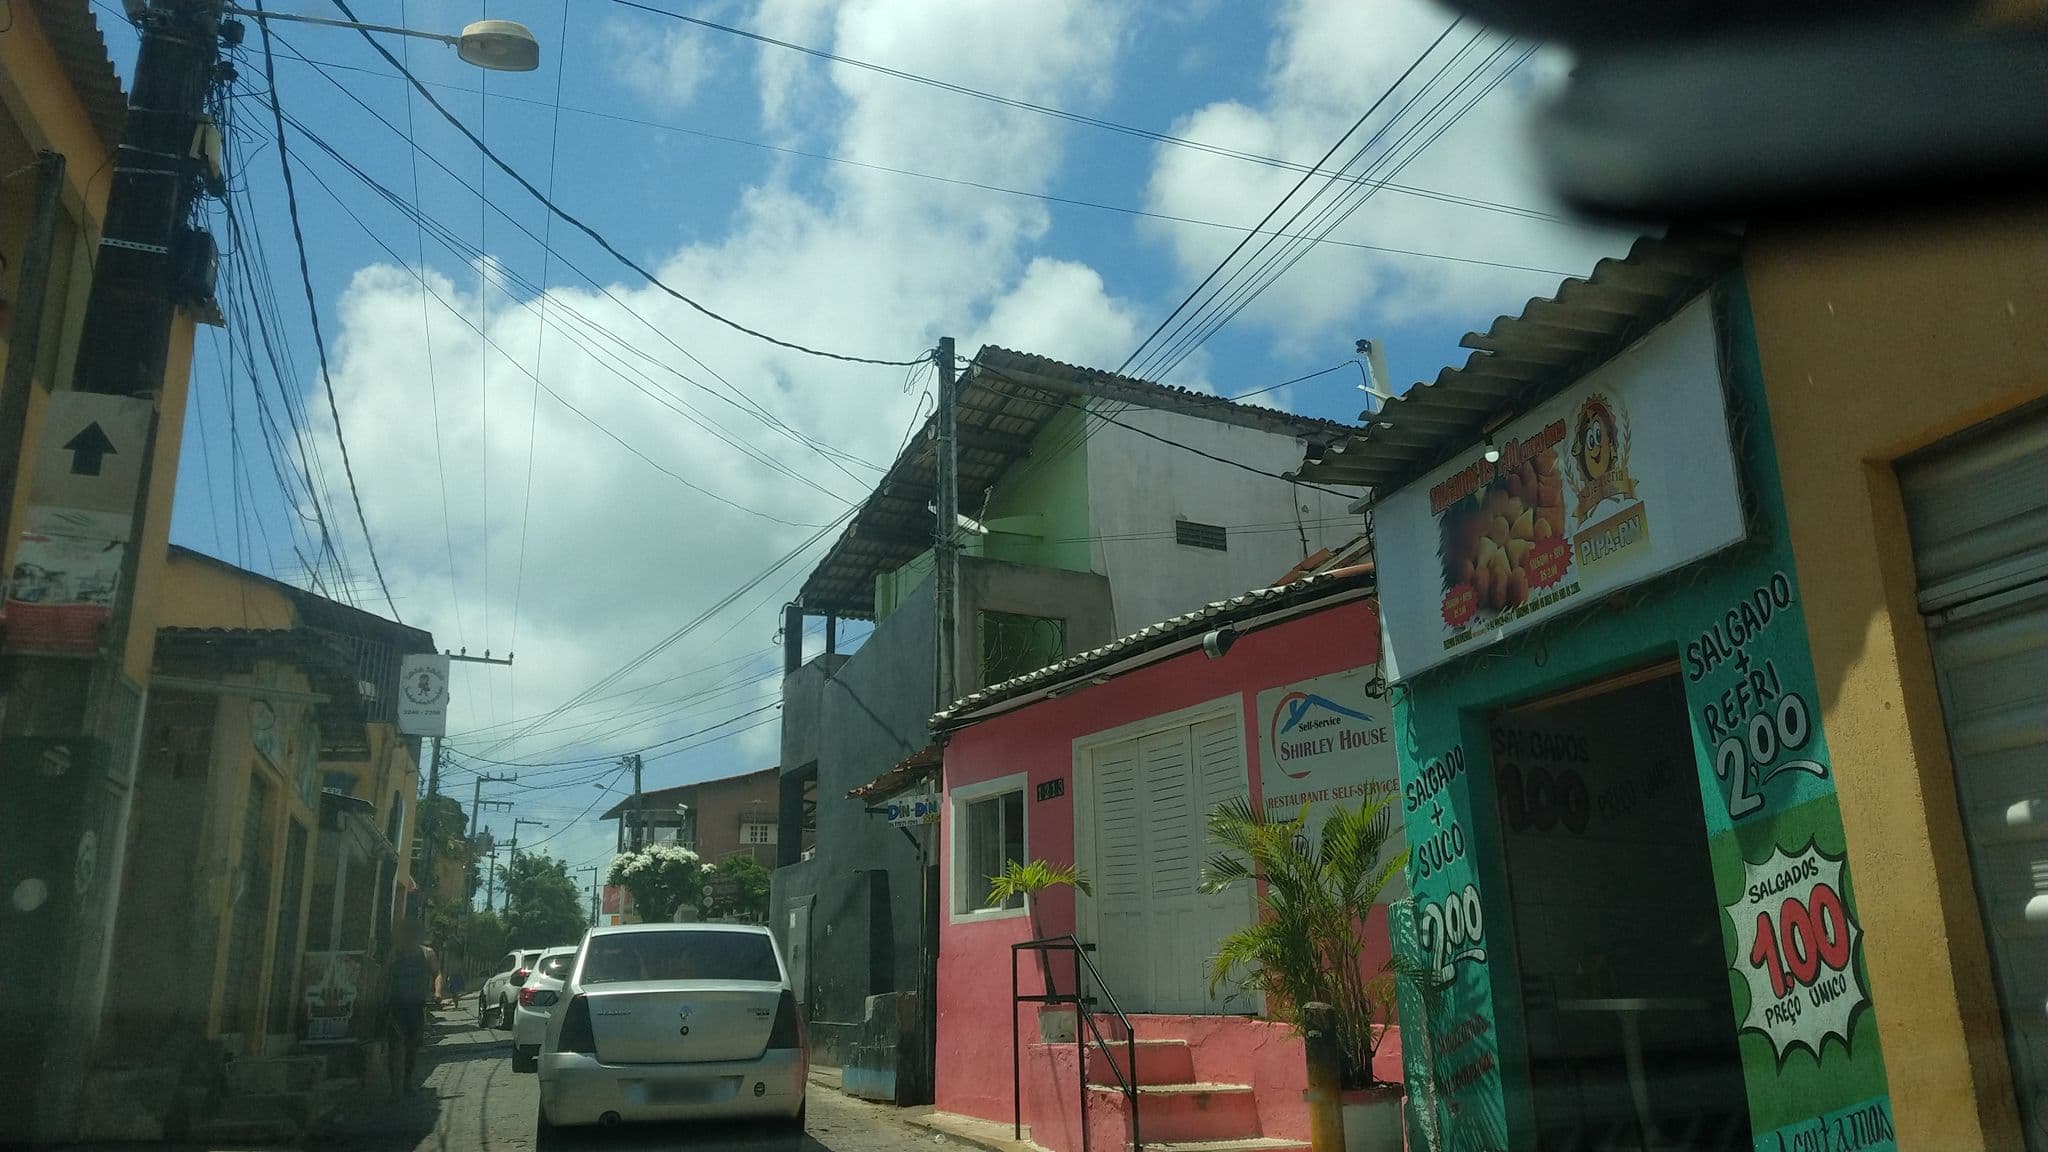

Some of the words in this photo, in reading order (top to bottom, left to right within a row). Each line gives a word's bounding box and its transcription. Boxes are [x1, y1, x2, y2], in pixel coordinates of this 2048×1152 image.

[1581, 515, 1643, 566] PIPA-RN
[1686, 573, 1791, 682] SALGADO
[1298, 716, 1342, 732] Self-Service
[1703, 660, 1781, 744] REFRI
[1280, 737, 1334, 761] SHIRLEY
[1339, 727, 1389, 751] HOUSE
[1716, 692, 1811, 821] 2,00
[1267, 788, 1329, 809] RESTAURANTE
[1405, 743, 1465, 813] SALGADO
[1418, 821, 1466, 879] SUCO
[1749, 855, 1820, 904] SALGADOS
[1750, 881, 1852, 1001] 1,00
[1764, 995, 1802, 1029] PREÇO
